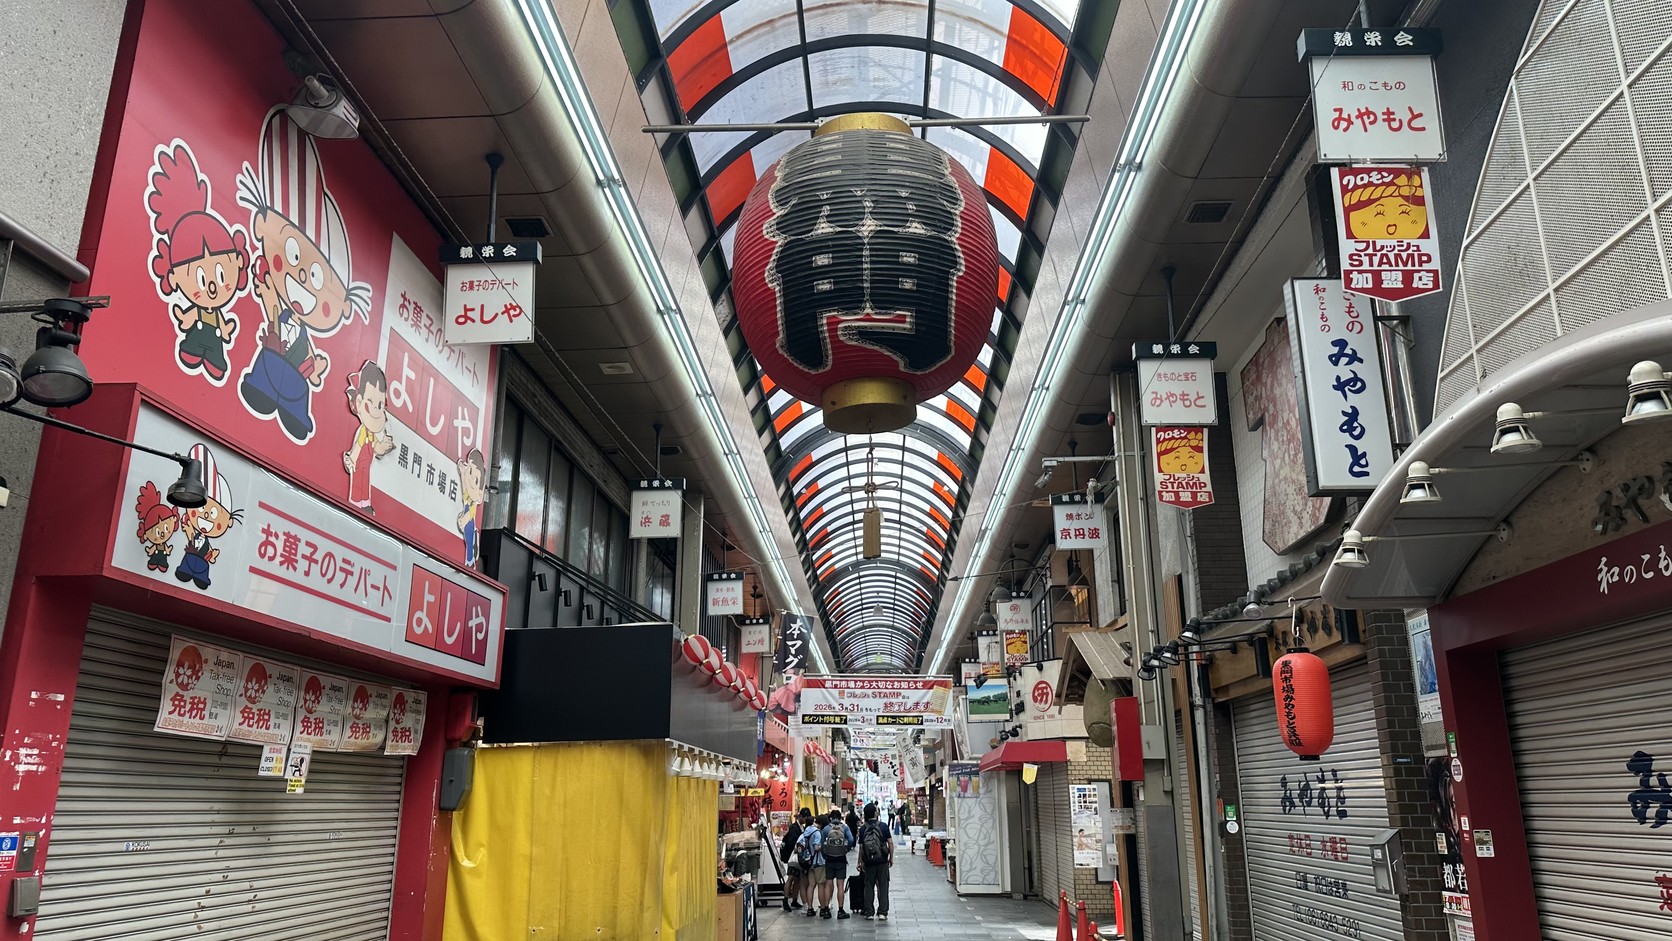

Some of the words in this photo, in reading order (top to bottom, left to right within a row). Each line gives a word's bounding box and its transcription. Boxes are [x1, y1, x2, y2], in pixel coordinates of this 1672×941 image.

[1341, 80, 1406, 91] 和のこもの
[1331, 106, 1426, 133] みやもと
[1342, 171, 1394, 190] クロモン
[1354, 240, 1421, 252] フレッシュ
[1347, 252, 1432, 268] STAMP
[460, 278, 519, 292] お菓子のデパート
[1349, 271, 1434, 289] 加盟店
[454, 302, 523, 326] よしや
[1313, 283, 1331, 333] 和のこもの
[1156, 372, 1197, 382] きものと宝石
[389, 351, 474, 457] よしや
[1150, 390, 1206, 408] みやもと
[1327, 338, 1370, 479] みやもと
[1157, 429, 1188, 441] クロモン
[397, 442, 459, 503] 黒門市場店
[1162, 473, 1201, 481] フレッシュ
[1159, 481, 1207, 490] STAMP
[1162, 491, 1210, 502] 加盟店
[1059, 527, 1101, 540] 京丹波
[257, 523, 393, 607] お菓子のデパート
[412, 580, 487, 655] よしや
[782, 618, 807, 685] 本マグロ
[213, 656, 236, 670] Japan.
[209, 669, 235, 684] Tax-free
[276, 671, 295, 684] Japan.
[825, 680, 923, 689] 黒門市場から大切なお知らせ
[215, 684, 232, 698] Shop
[273, 683, 294, 697] Tax-free
[871, 691, 902, 699] STAMP
[168, 691, 207, 721] 免税
[277, 697, 291, 709] Shop
[1280, 659, 1304, 747] 黒門市場みやもと呉服
[238, 704, 271, 731] 免税
[803, 715, 847, 724] ポイント付与終了
[299, 715, 325, 737] 免税
[348, 721, 372, 740] 免税
[391, 726, 413, 743] 免税
[1288, 832, 1312, 856] 定休日
[1320, 836, 1349, 861] 水曜日
